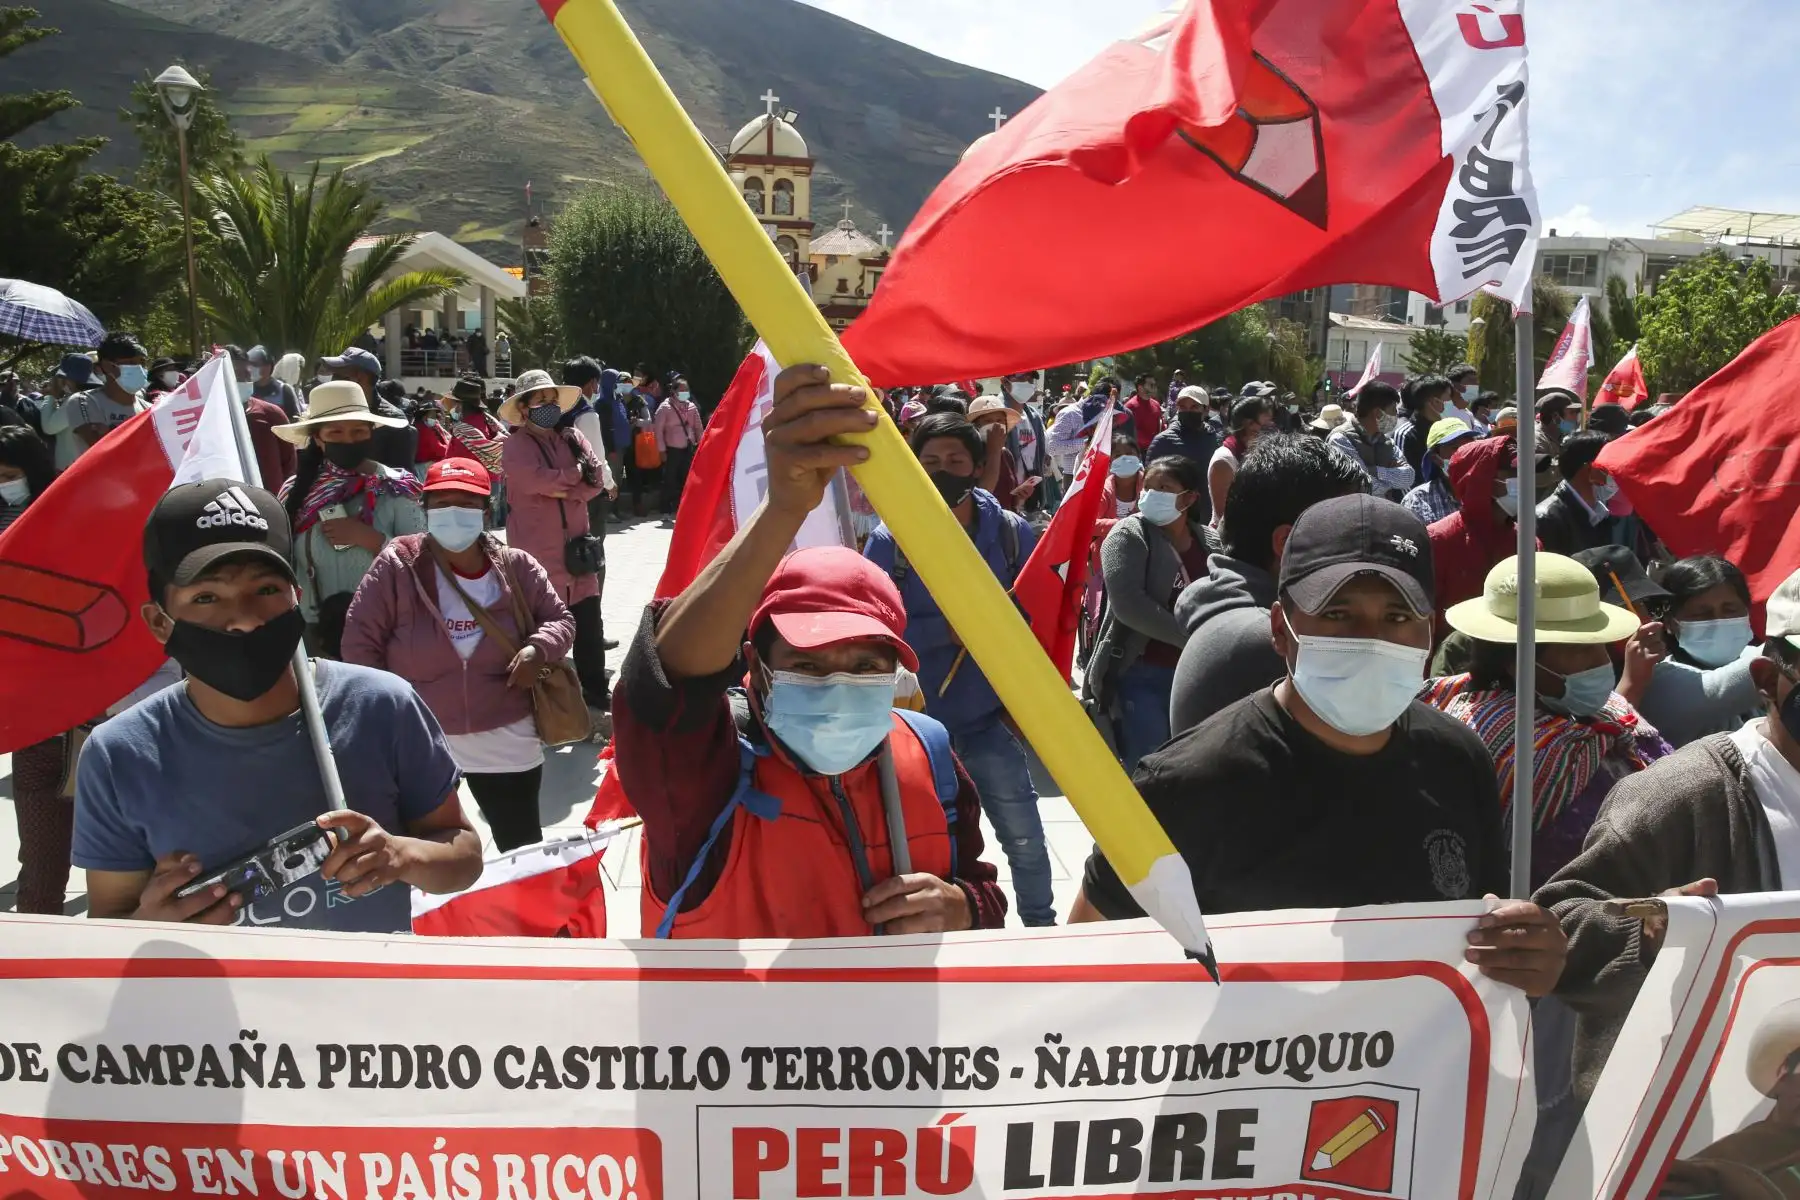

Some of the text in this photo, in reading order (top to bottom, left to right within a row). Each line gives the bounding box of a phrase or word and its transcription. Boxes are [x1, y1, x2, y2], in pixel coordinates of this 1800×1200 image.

[196, 508, 269, 531] adidas
[56, 1029, 306, 1089] CAMPAÑA
[316, 1044, 482, 1090] PEDRO
[493, 1044, 731, 1091] CASTILLO
[741, 1046, 1000, 1092] TERRONES
[1010, 1067, 1024, 1079] -
[1034, 1031, 1395, 1083] ÑAHUIMPUQUIO
[182, 1147, 259, 1196] EN
[267, 1150, 347, 1200] UN
[360, 1137, 482, 1200] PAÍS
[493, 1153, 637, 1200] RICO!
[732, 1108, 1259, 1200] PERÚ LIBRE
